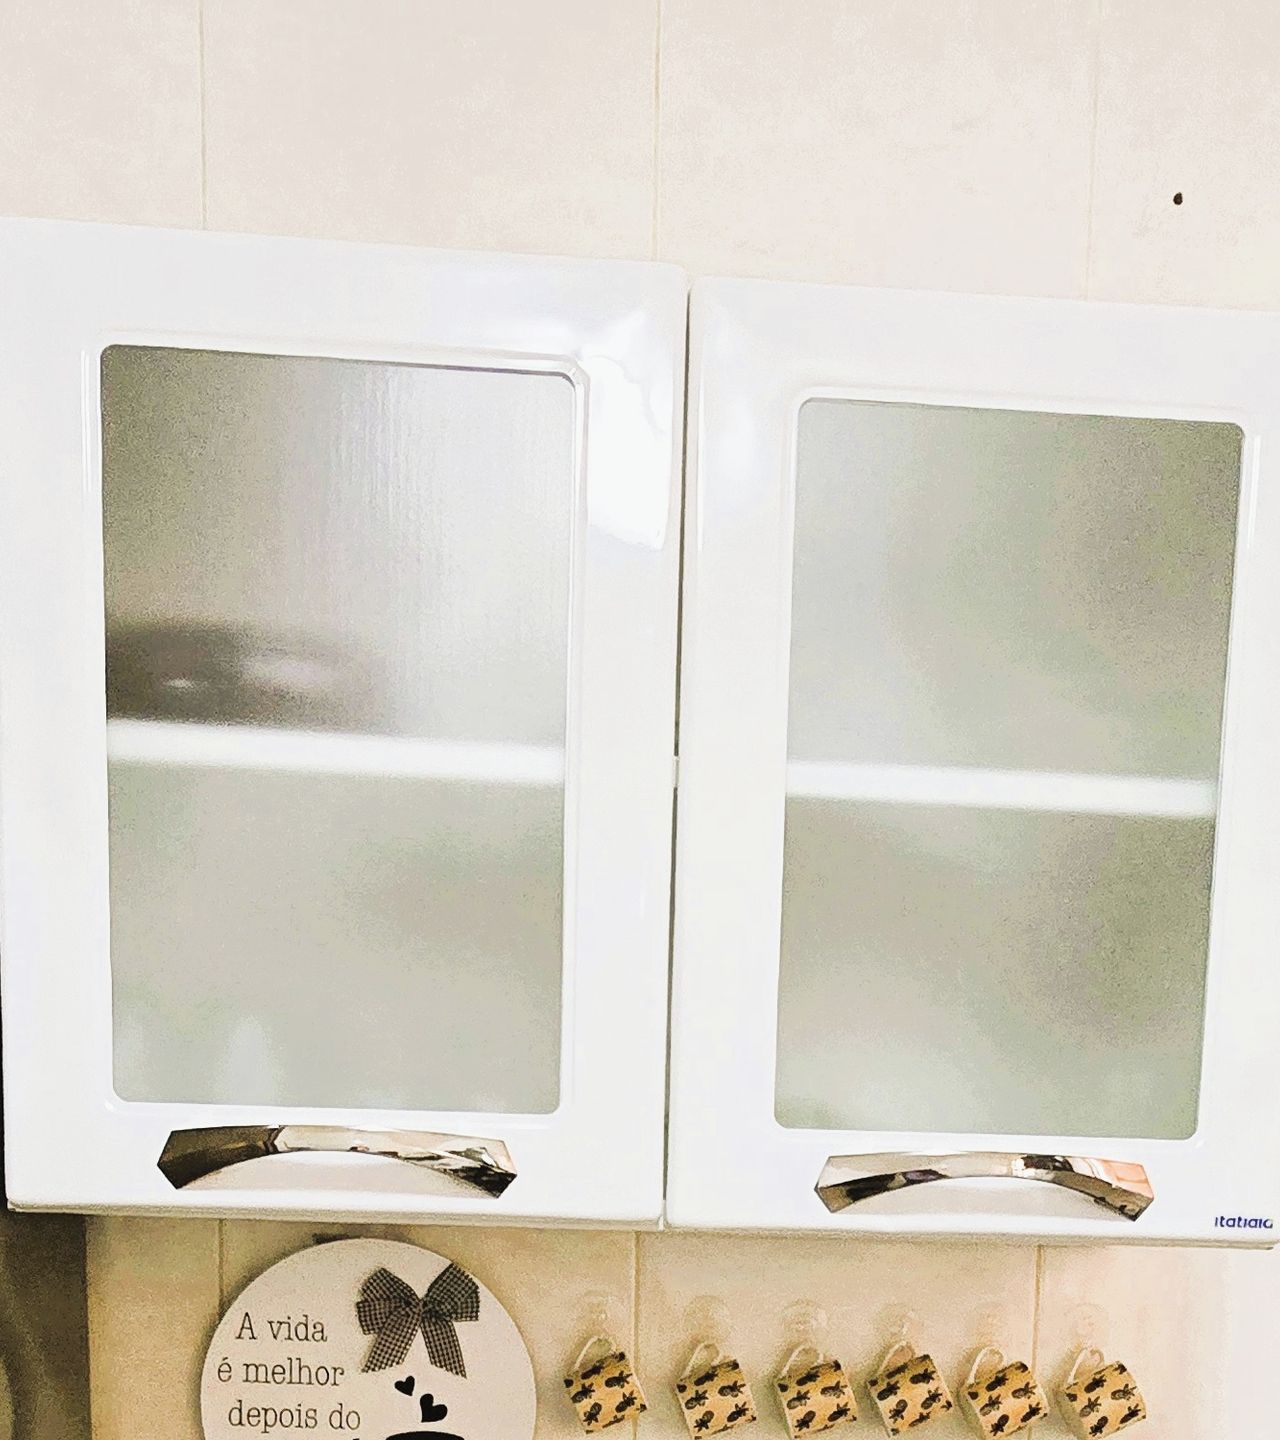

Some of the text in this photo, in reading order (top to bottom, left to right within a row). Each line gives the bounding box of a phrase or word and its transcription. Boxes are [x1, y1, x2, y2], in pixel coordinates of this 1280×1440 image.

[235, 1312, 328, 1343] A vida
[217, 1357, 345, 1387] é melhor
[228, 1400, 361, 1434] depois do
